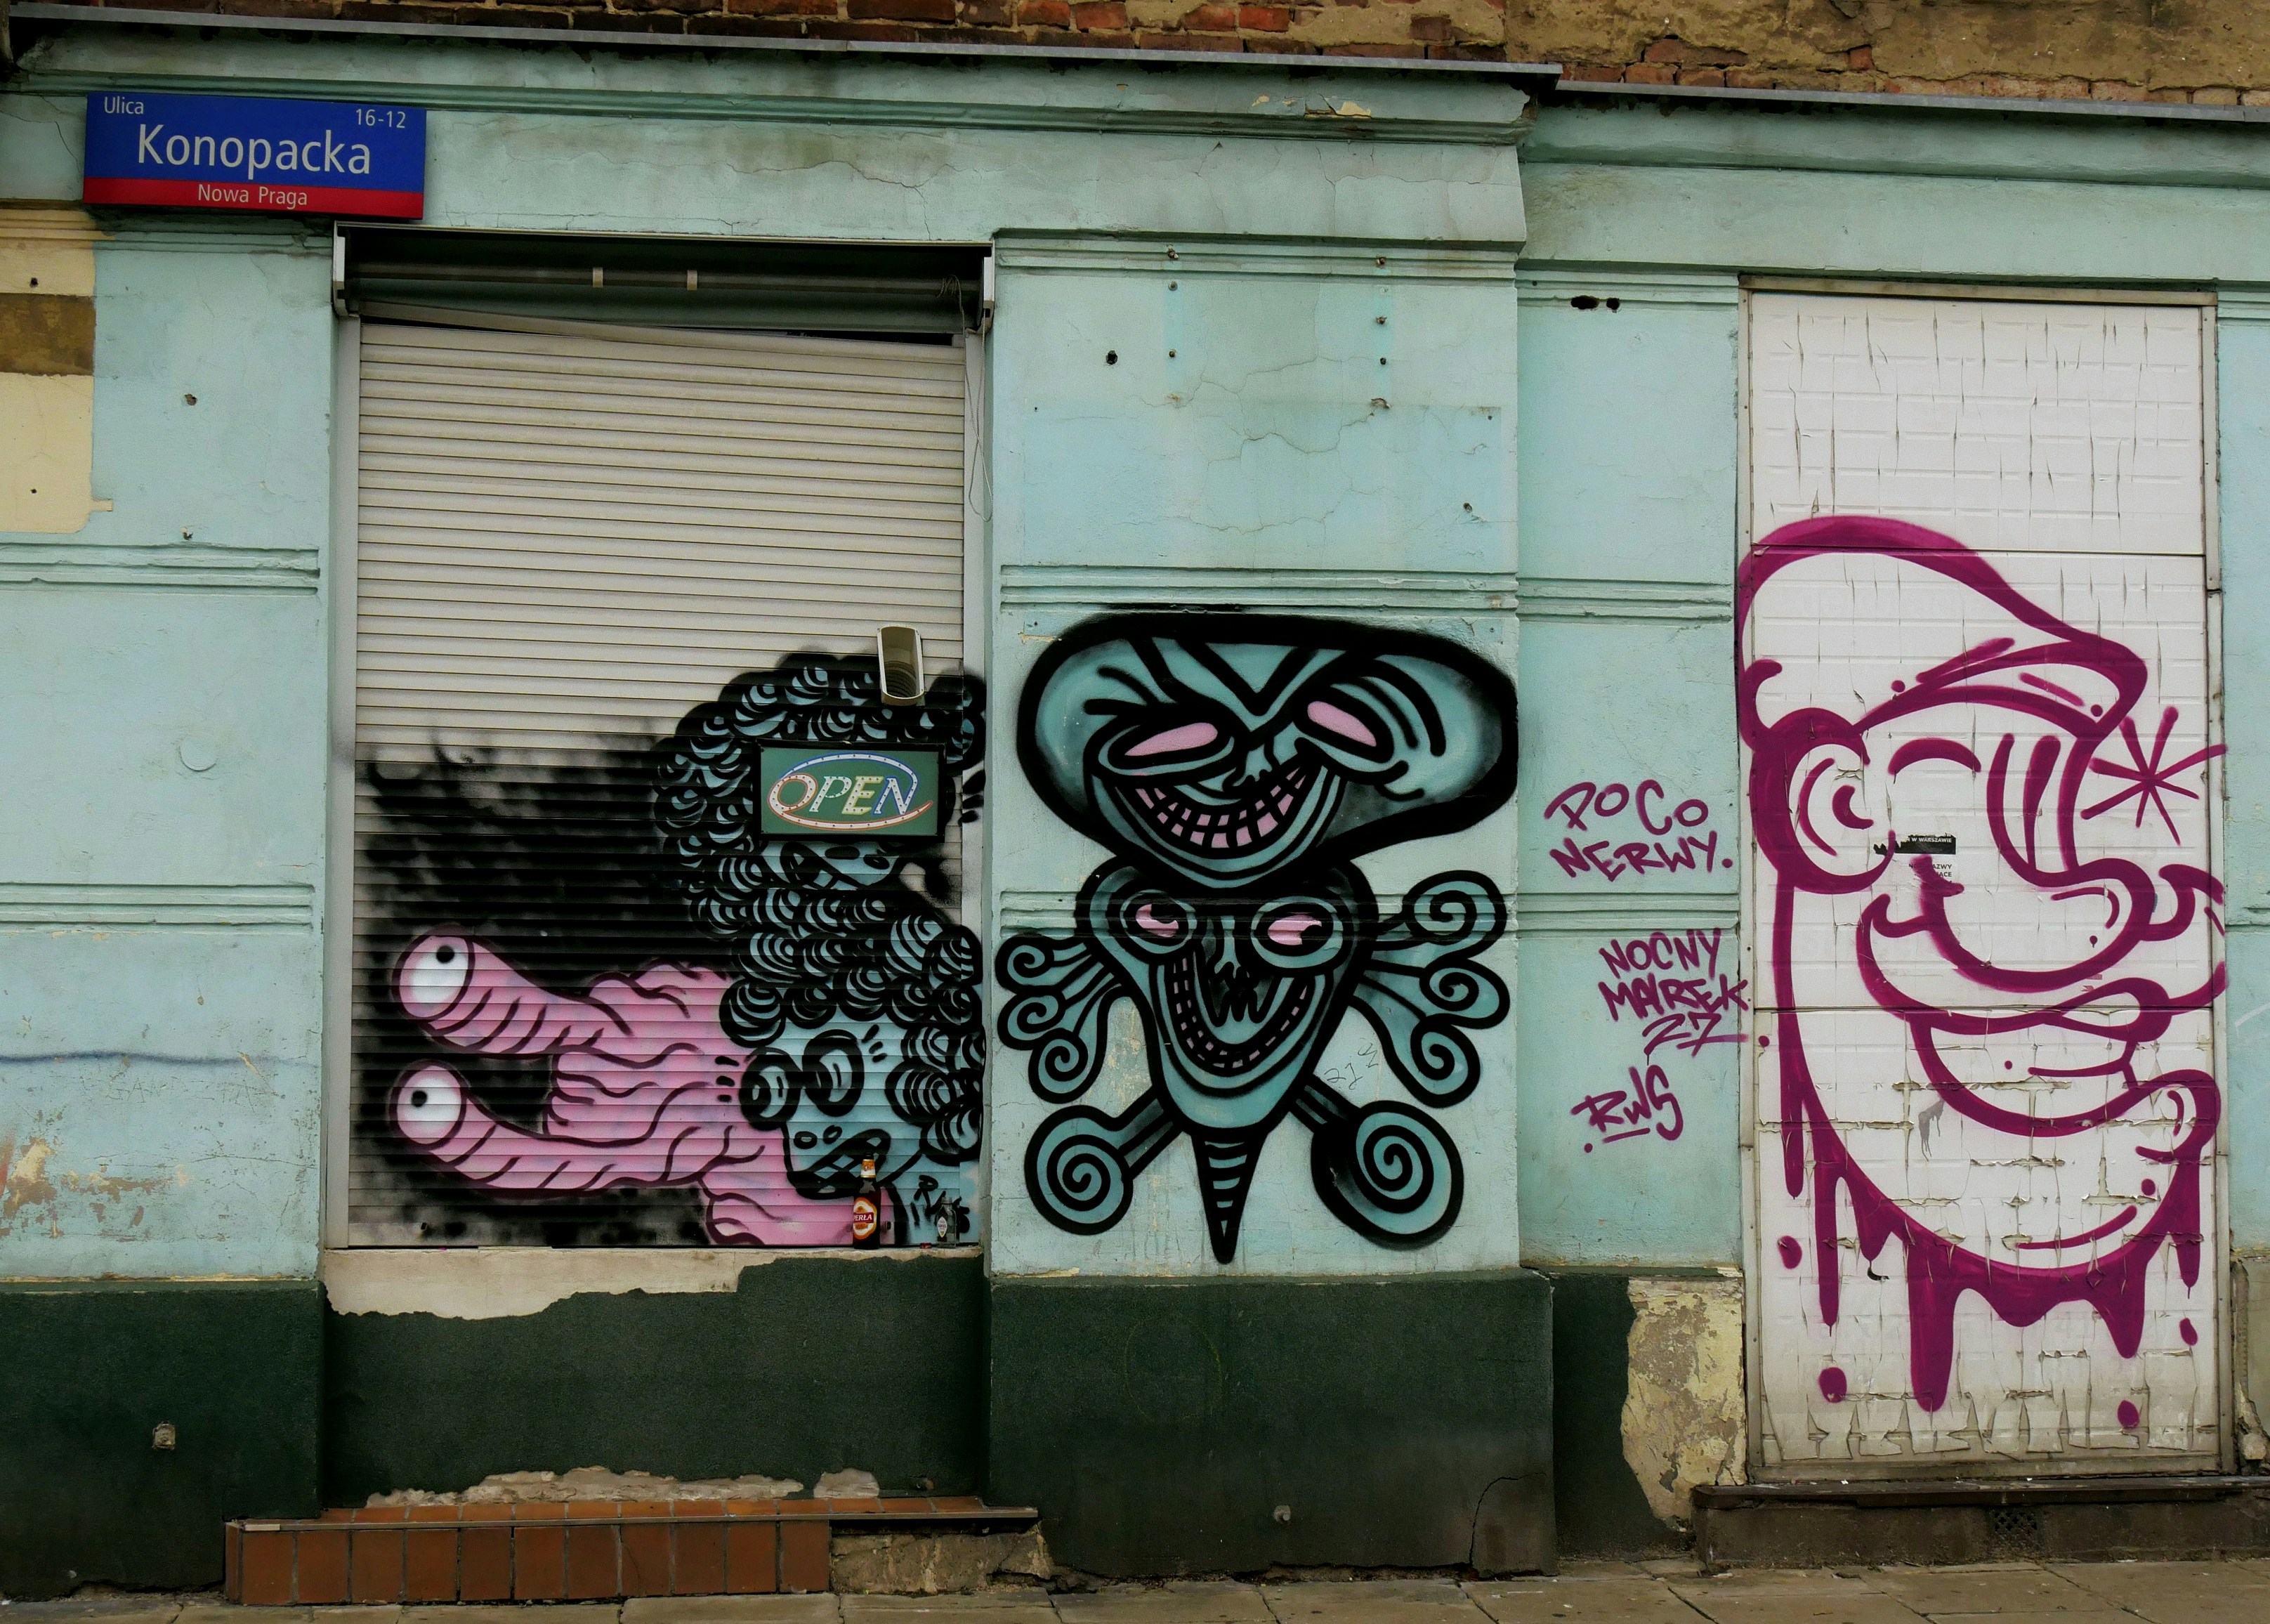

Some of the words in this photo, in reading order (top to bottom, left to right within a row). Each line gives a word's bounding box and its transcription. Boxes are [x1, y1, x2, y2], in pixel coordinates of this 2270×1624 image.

[104, 96, 144, 115] Ulica
[355, 108, 406, 129] 16-12
[138, 123, 371, 180] Konopacka
[197, 184, 249, 203] Nowa
[258, 186, 308, 209] Praga
[767, 768, 921, 823] OPEN
[1598, 927, 1721, 981] NOCNY
